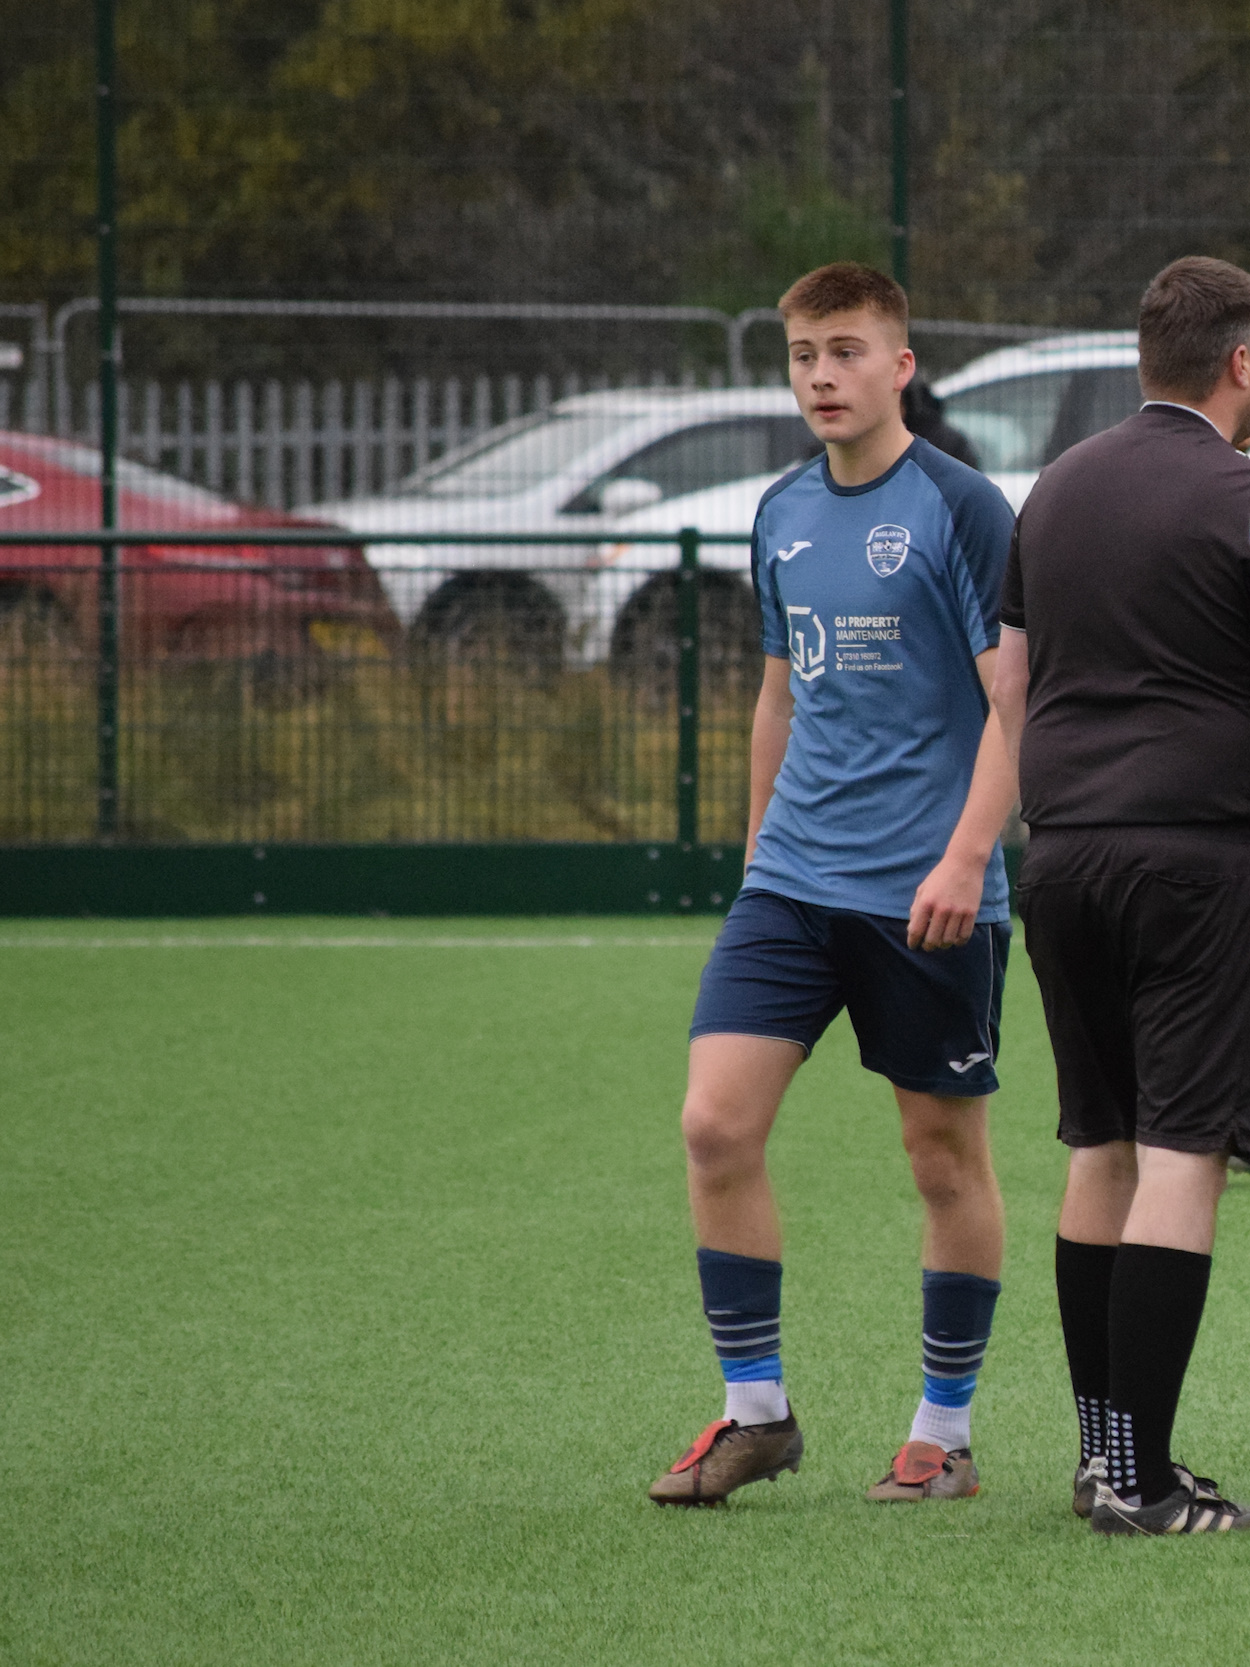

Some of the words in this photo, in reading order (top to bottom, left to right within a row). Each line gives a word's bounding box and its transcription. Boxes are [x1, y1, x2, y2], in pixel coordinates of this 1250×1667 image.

[835, 616, 846, 627] GJ
[848, 616, 900, 627] PROPERTY
[836, 630, 901, 640] MAINTENANCE
